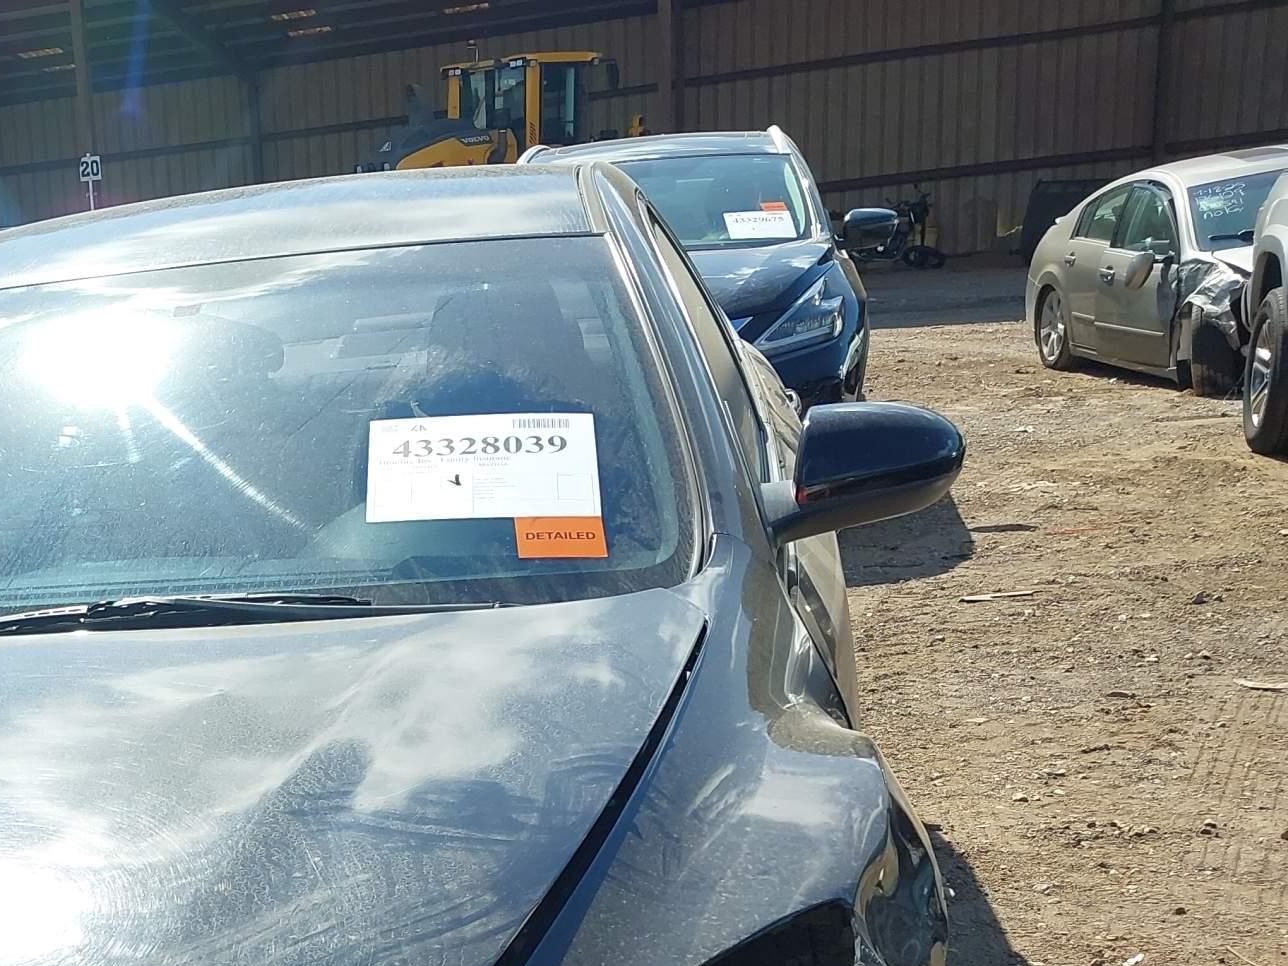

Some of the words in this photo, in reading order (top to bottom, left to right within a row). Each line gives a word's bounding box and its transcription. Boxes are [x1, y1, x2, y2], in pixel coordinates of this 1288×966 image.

[81, 160, 100, 177] 20
[392, 435, 568, 458] 43328039
[525, 531, 596, 541] DETAILED
